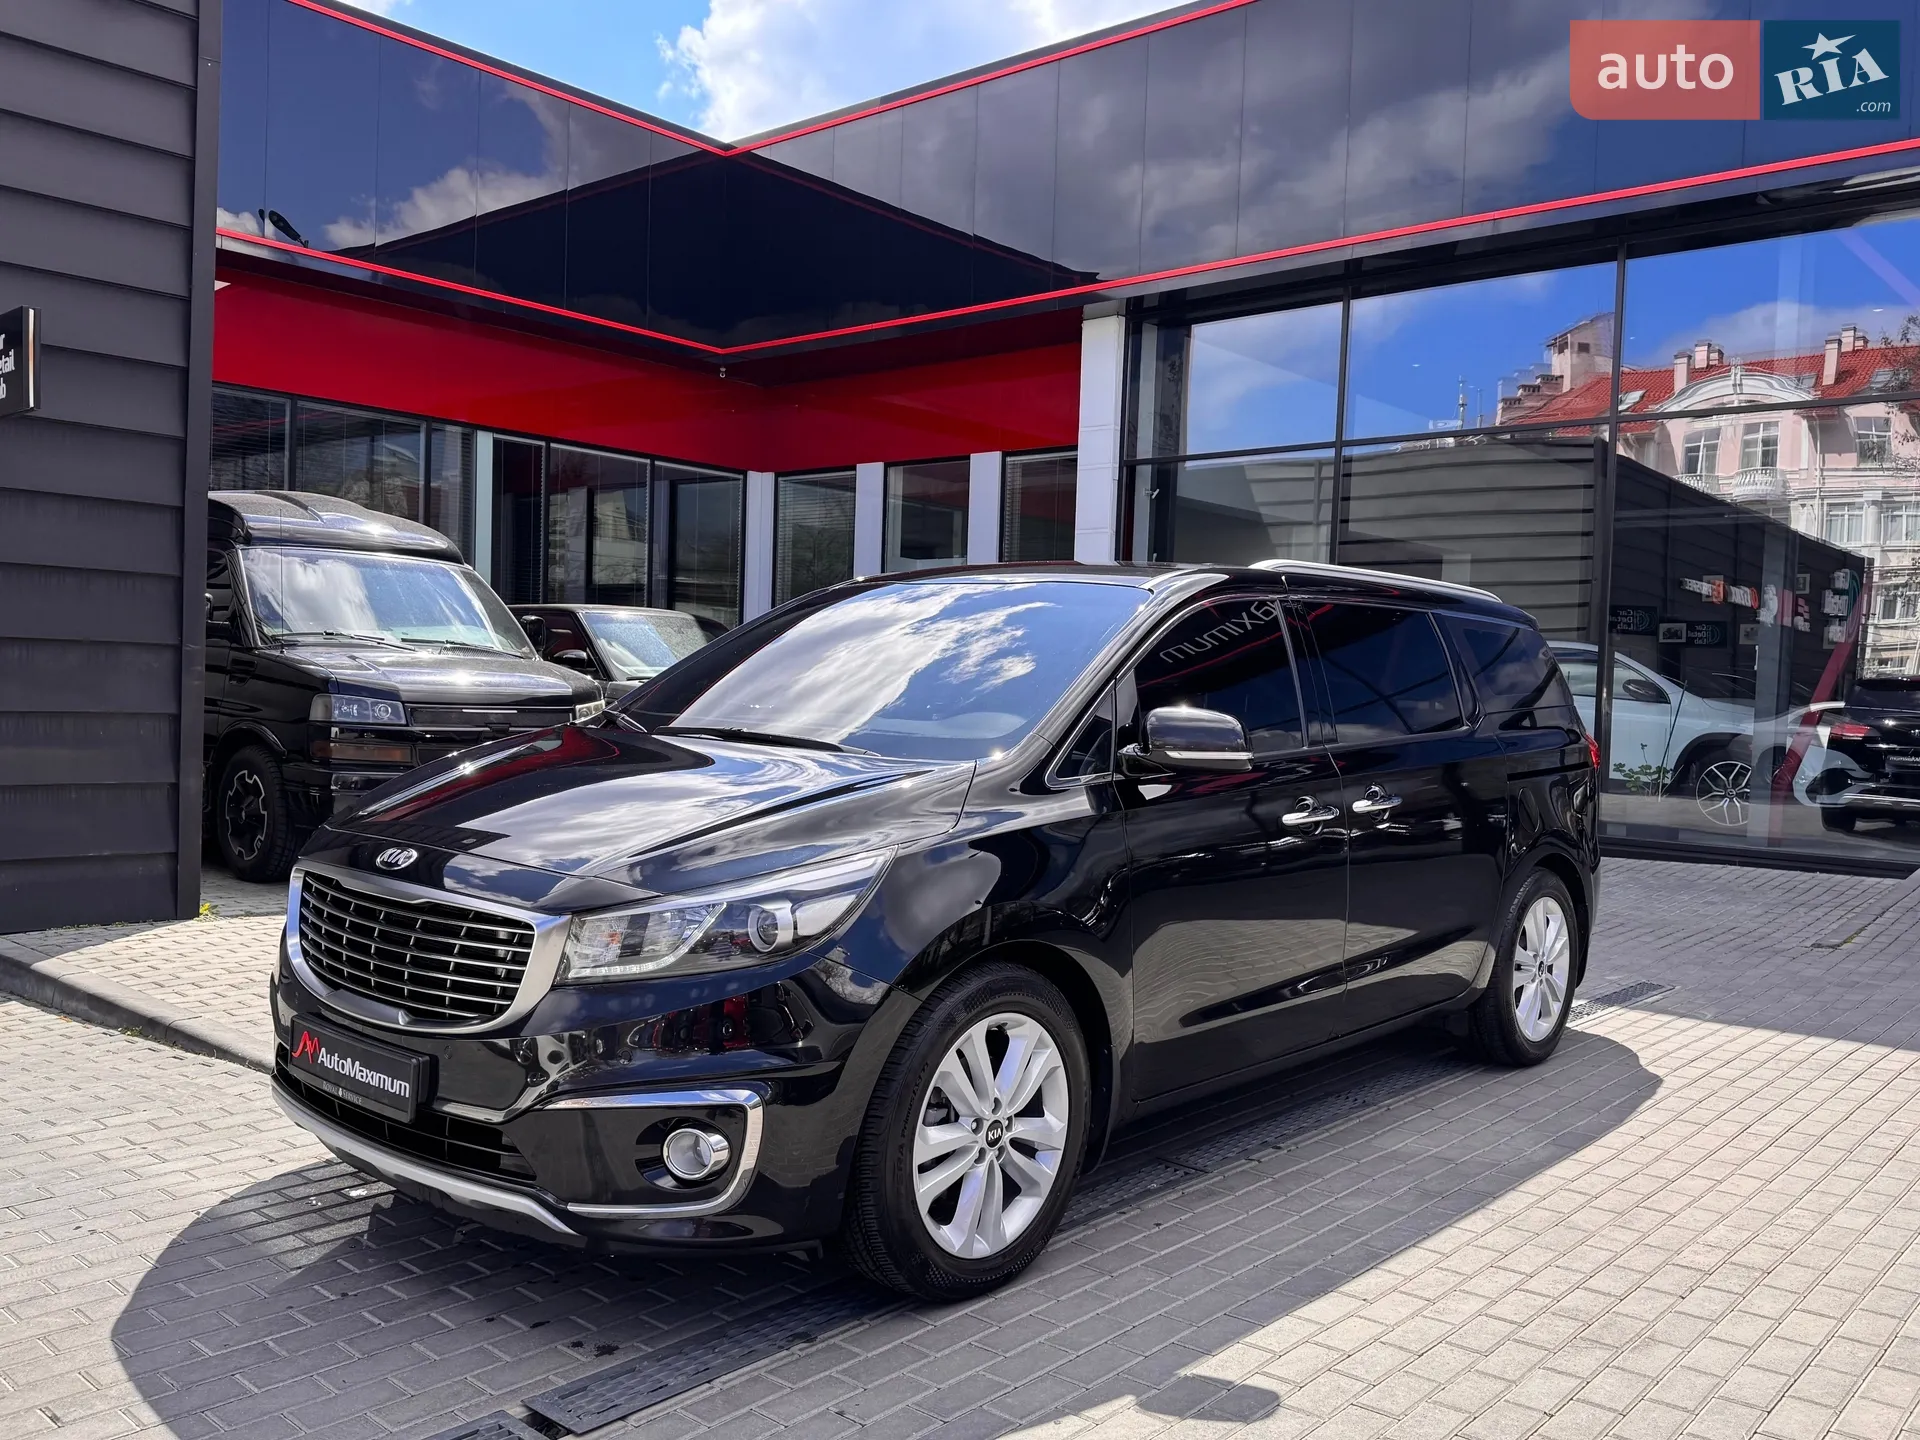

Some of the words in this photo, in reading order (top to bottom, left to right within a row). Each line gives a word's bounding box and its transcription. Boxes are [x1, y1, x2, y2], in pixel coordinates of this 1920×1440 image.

[379, 848, 411, 866] KIA
[317, 1047, 410, 1098] AutoMaximum
[988, 1127, 1002, 1141] KIA
